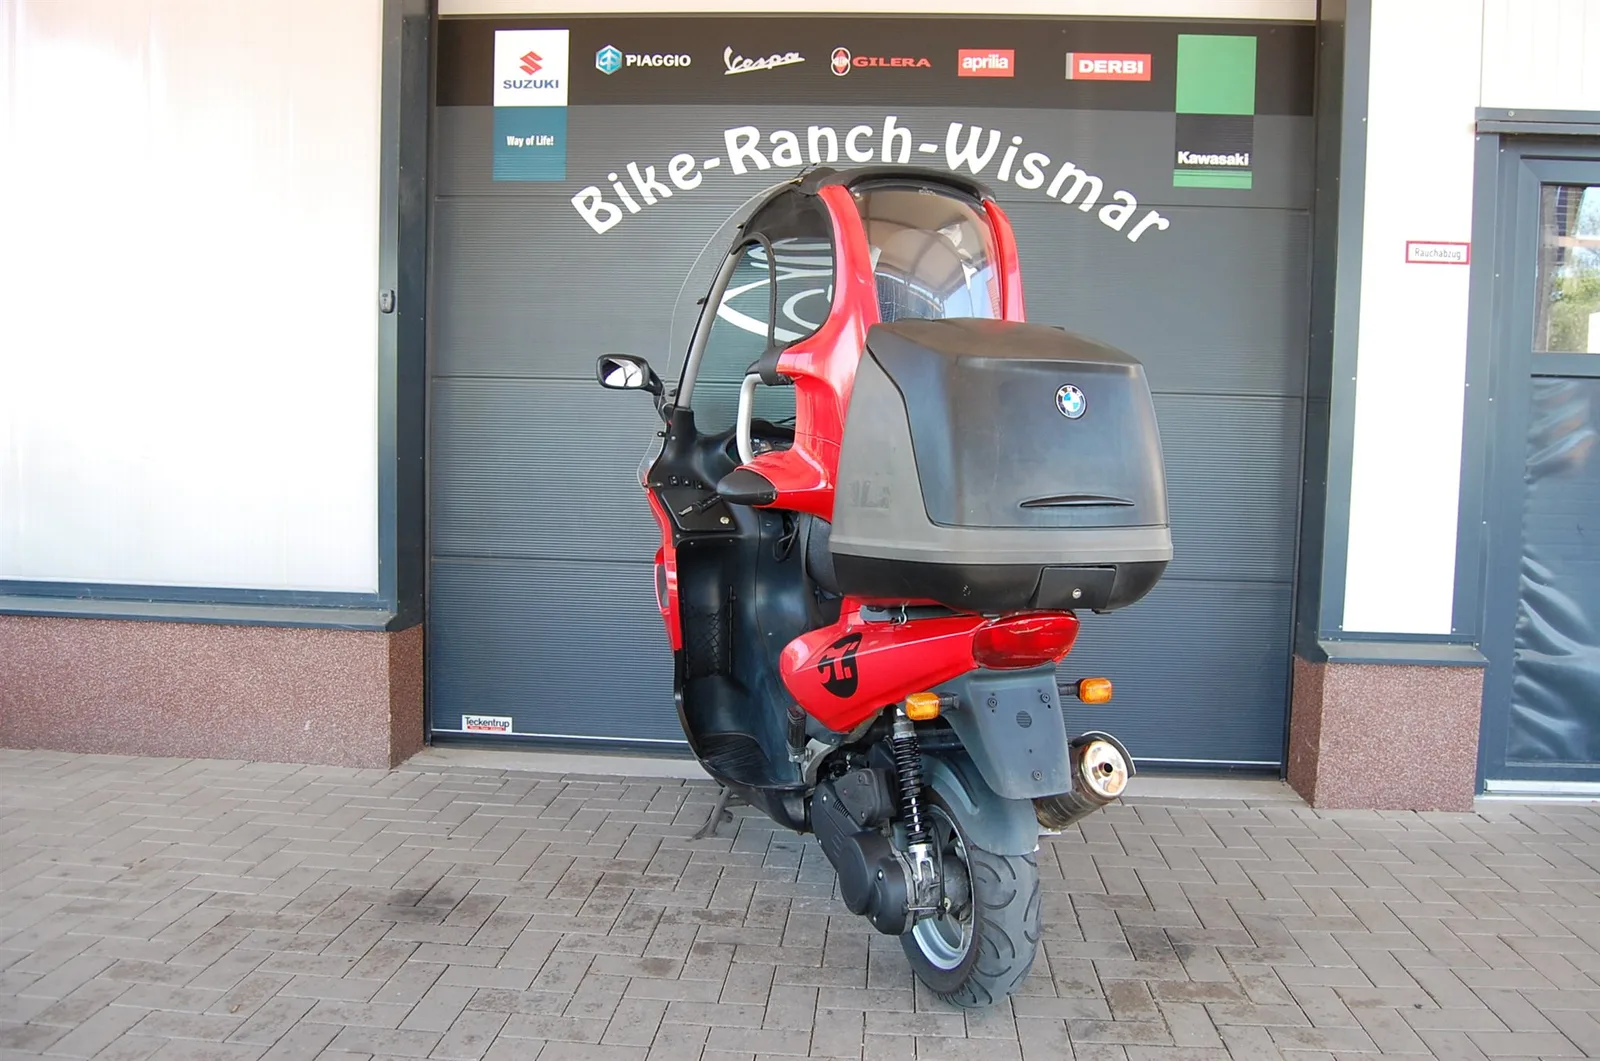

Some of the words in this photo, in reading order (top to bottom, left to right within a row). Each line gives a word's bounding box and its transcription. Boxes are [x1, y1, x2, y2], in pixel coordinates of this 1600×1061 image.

[625, 54, 691, 67] PIAGGIO
[723, 46, 805, 75] Vespa
[852, 56, 932, 68] GILERA
[962, 53, 1009, 72] aprilia
[1079, 59, 1144, 74] DERBI
[503, 80, 559, 89] SUZUKI
[506, 135, 524, 147] Way
[525, 135, 534, 146] of
[536, 135, 554, 146] Life!
[1177, 151, 1249, 166] Kawasaki
[570, 115, 1170, 243] Bike-Ranch-Wismar
[1414, 247, 1461, 260] Rauchabzug
[465, 716, 510, 729] Teckentrup
